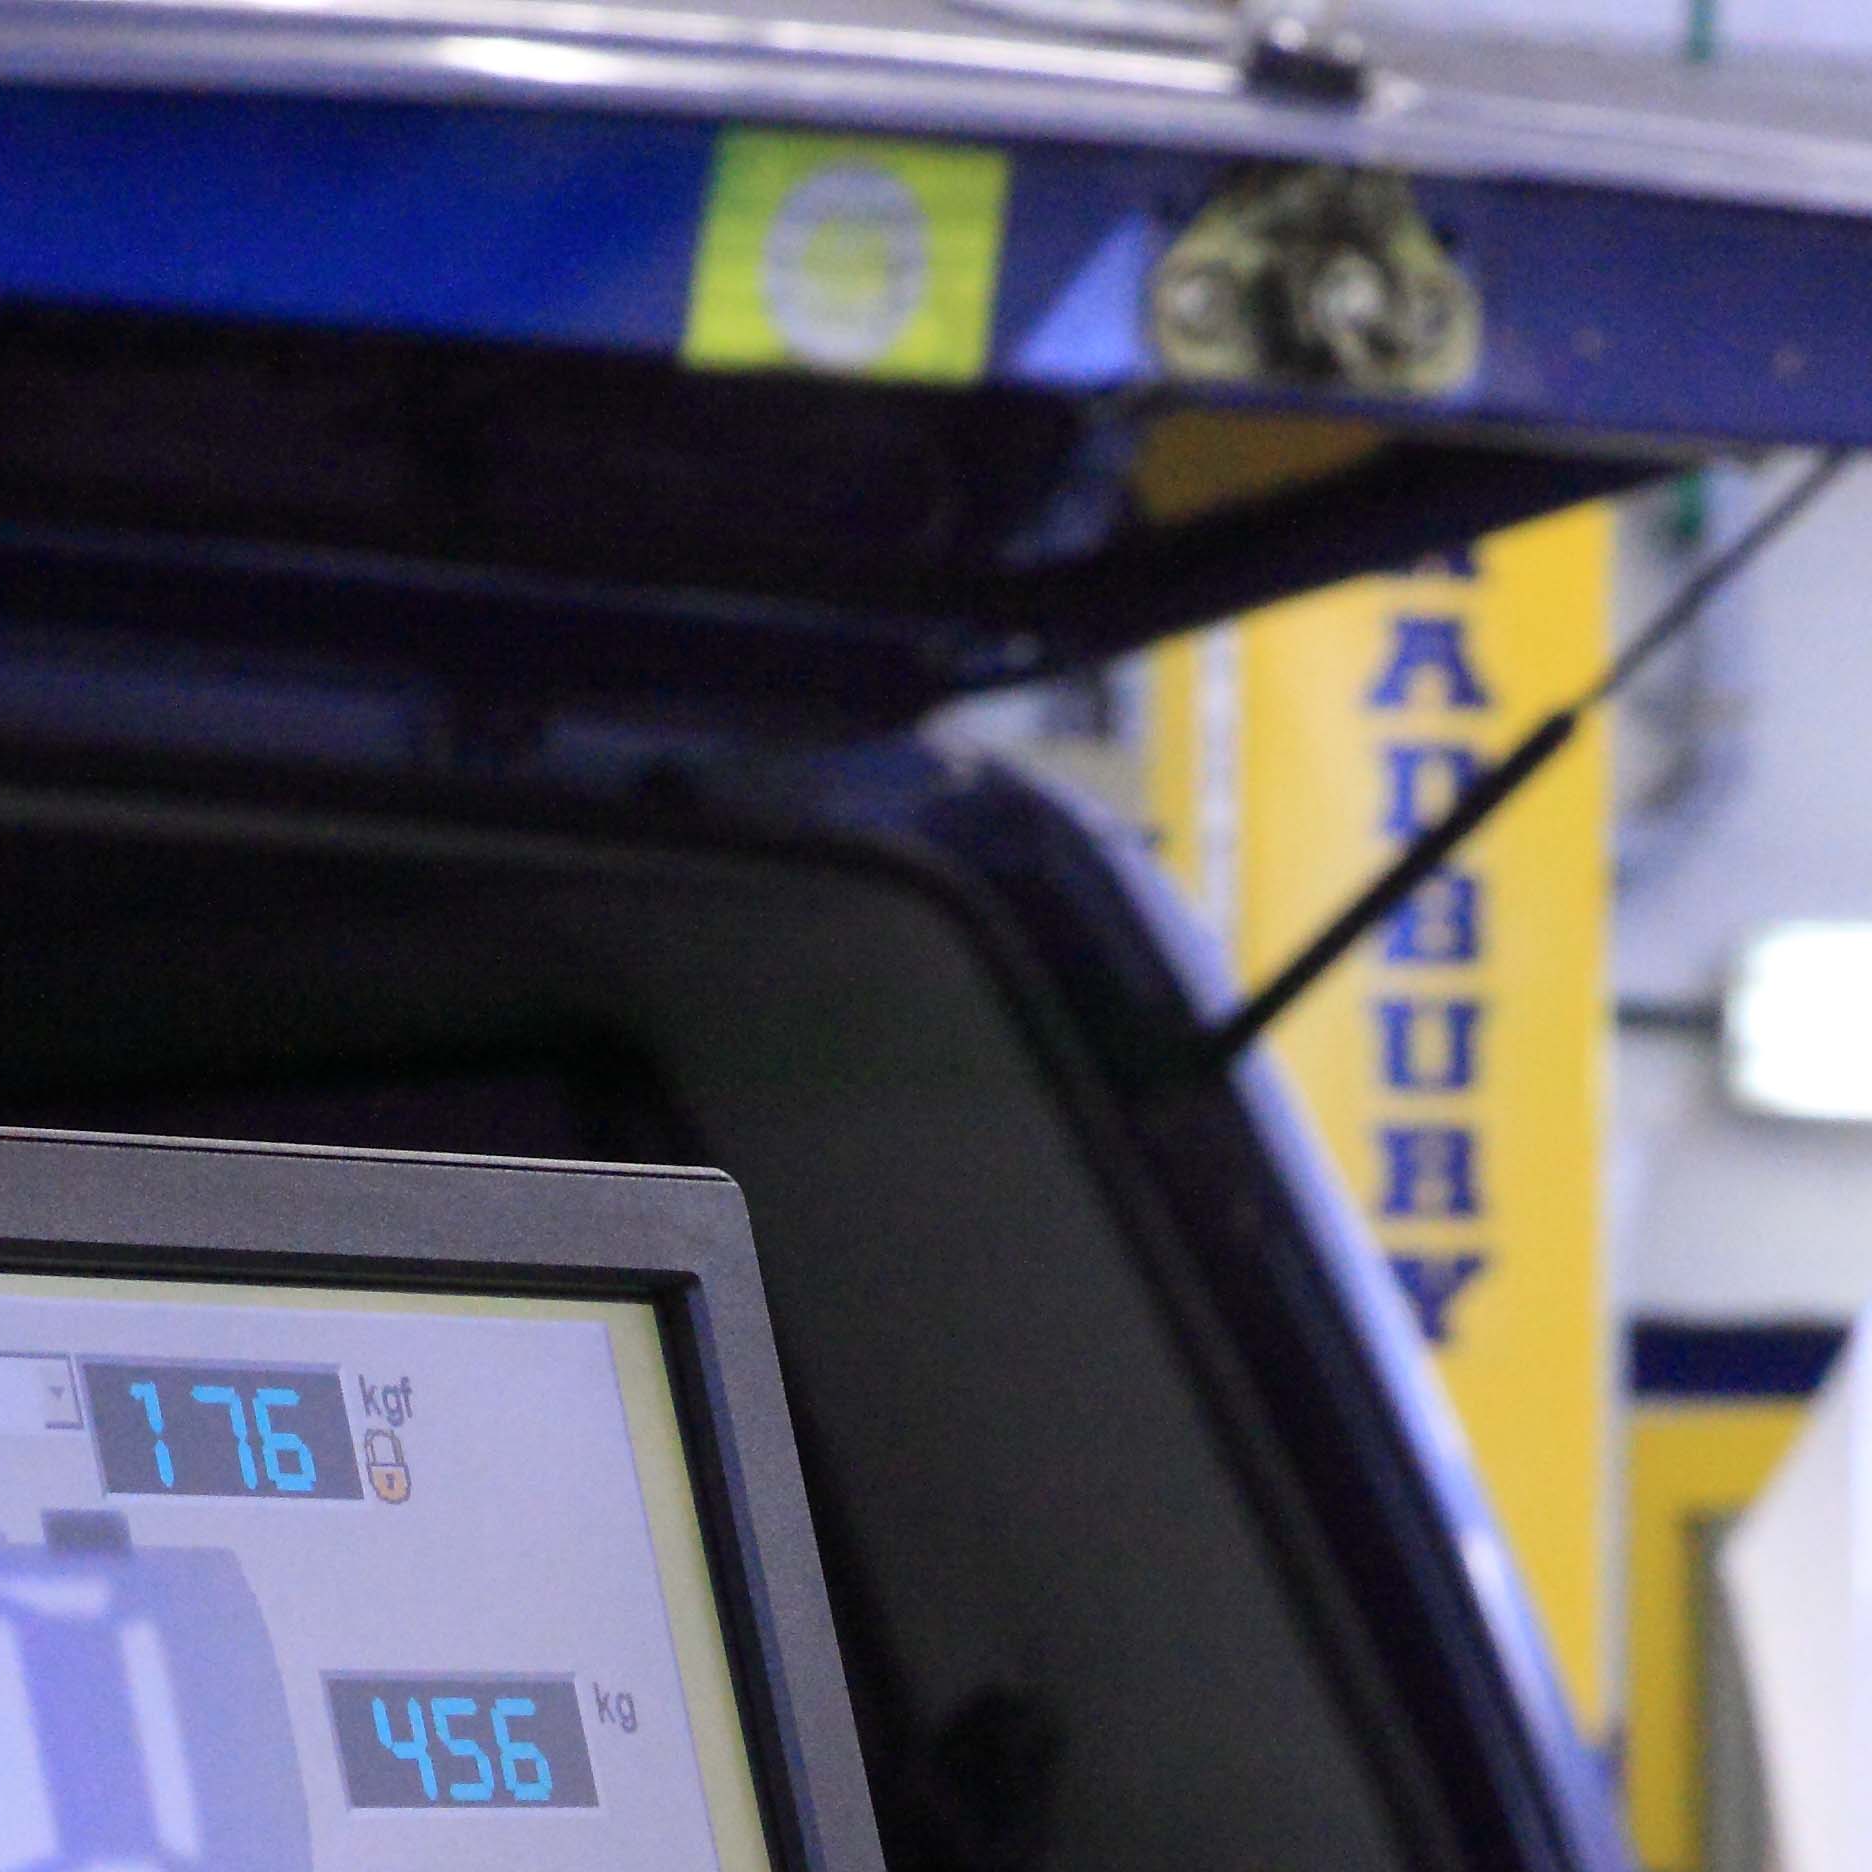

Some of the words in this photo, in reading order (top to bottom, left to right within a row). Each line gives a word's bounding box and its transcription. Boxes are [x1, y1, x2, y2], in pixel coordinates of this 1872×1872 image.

[1366, 548, 1488, 1346] ADBURY
[129, 1380, 318, 1493] 176
[359, 1374, 414, 1425] kgf
[371, 1695, 554, 1802] 456
[593, 1681, 637, 1732] kg
